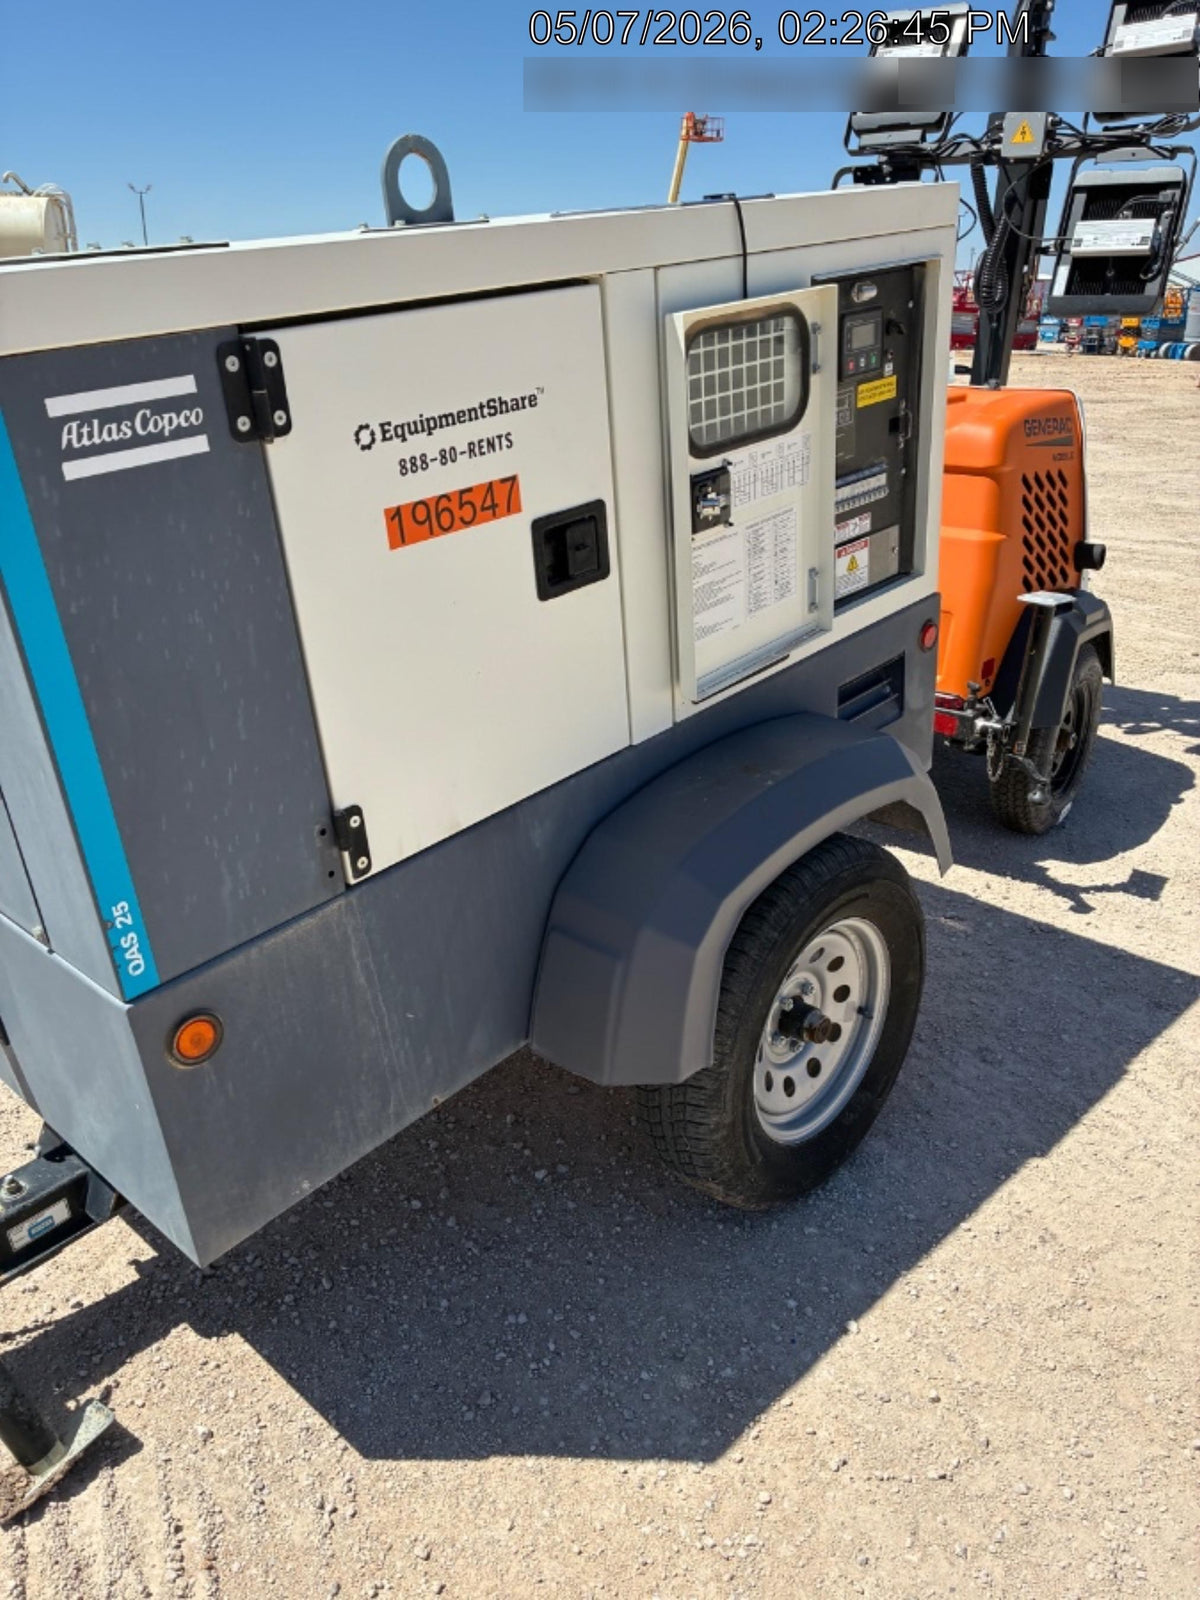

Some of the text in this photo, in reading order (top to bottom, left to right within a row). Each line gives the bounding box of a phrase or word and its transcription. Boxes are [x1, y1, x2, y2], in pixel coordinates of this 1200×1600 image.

[61, 407, 204, 450] Atlas Copco
[1023, 416, 1074, 438] GENERAC
[398, 431, 514, 477] 888-80-RENTS
[389, 475, 518, 545] 196547
[111, 901, 145, 976] OAS 25
